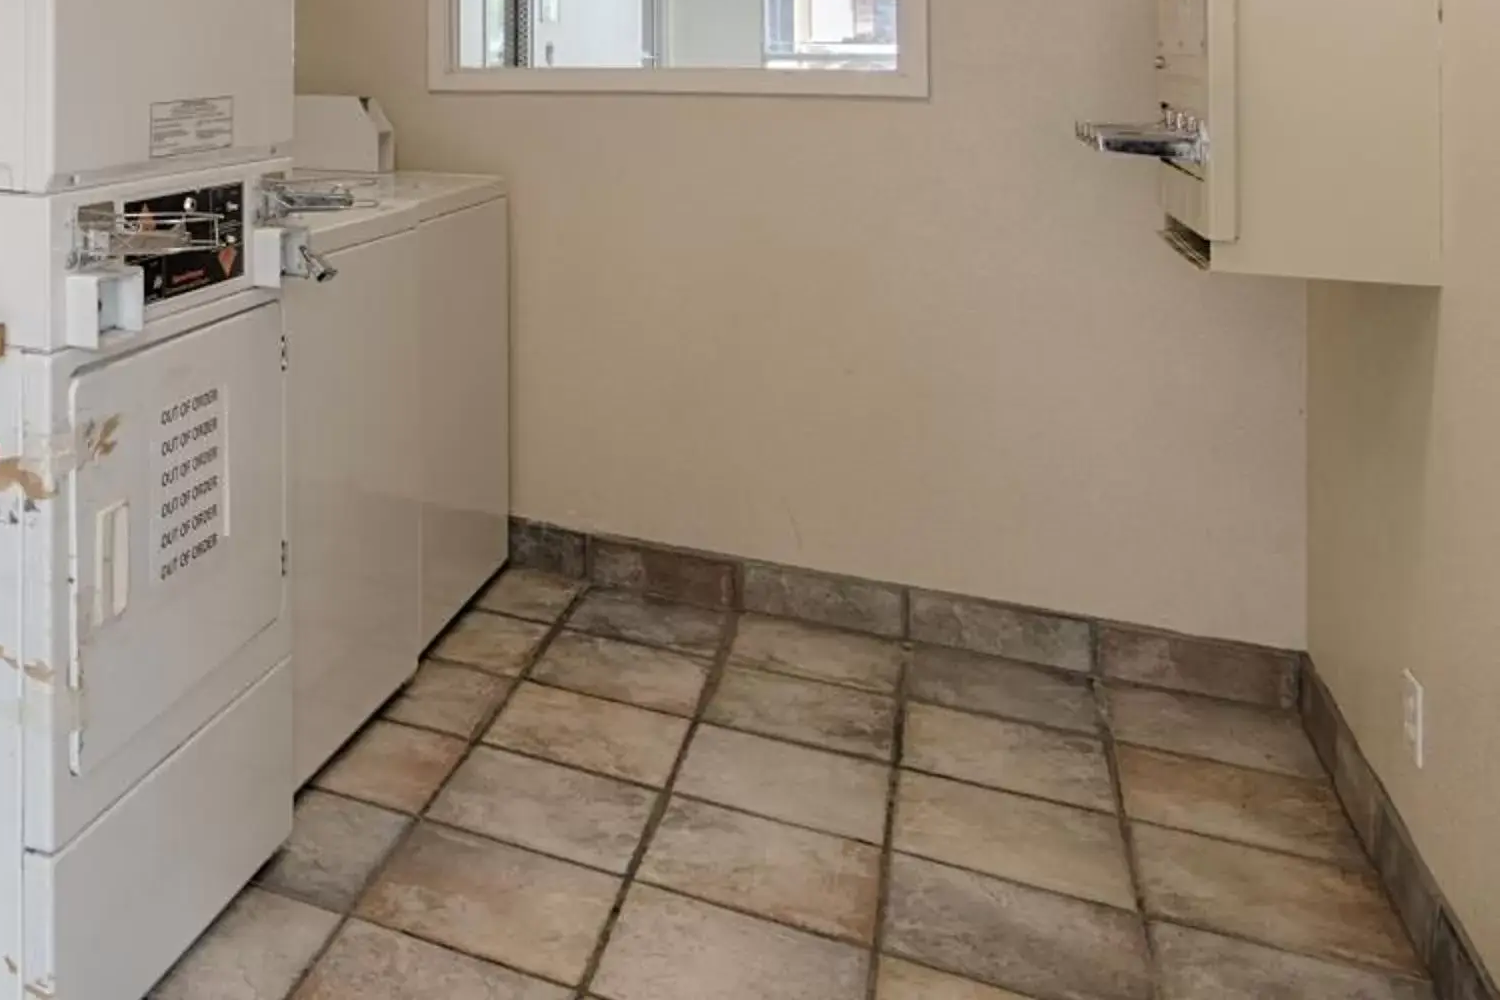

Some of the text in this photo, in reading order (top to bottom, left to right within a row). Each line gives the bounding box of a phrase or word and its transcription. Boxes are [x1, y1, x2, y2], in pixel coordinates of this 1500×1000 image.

[160, 388, 218, 425] OUT OF ORDER
[160, 417, 218, 456] OUT OF ORDER
[160, 446, 218, 487] OUT OF ORDER
[160, 475, 218, 518] OUT OF ORDER
[160, 504, 218, 548] OUT OF ORDER
[160, 533, 218, 580] OUT OF ORDER
